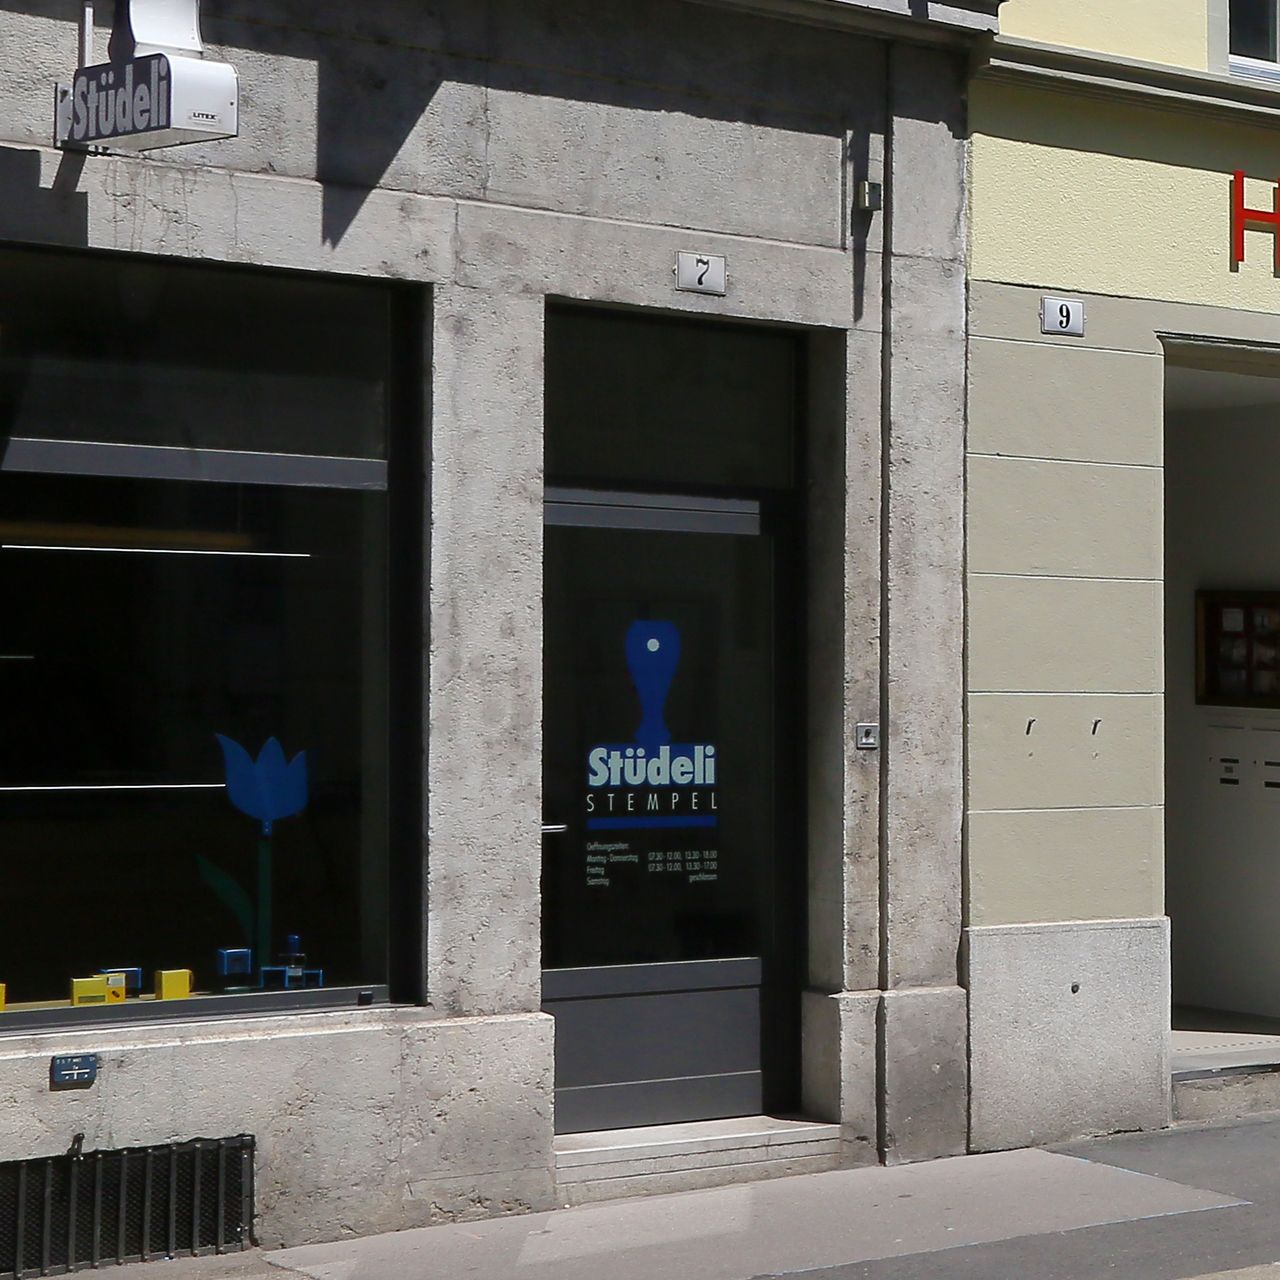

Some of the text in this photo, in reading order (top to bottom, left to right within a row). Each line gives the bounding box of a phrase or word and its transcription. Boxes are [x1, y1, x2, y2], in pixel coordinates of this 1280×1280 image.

[73, 56, 168, 140] Stüdeli
[192, 111, 218, 120] LITEX
[695, 257, 710, 286] 7
[1059, 303, 1071, 329] 9
[588, 745, 715, 786] Stüdeli
[586, 792, 718, 812] STEMPEL
